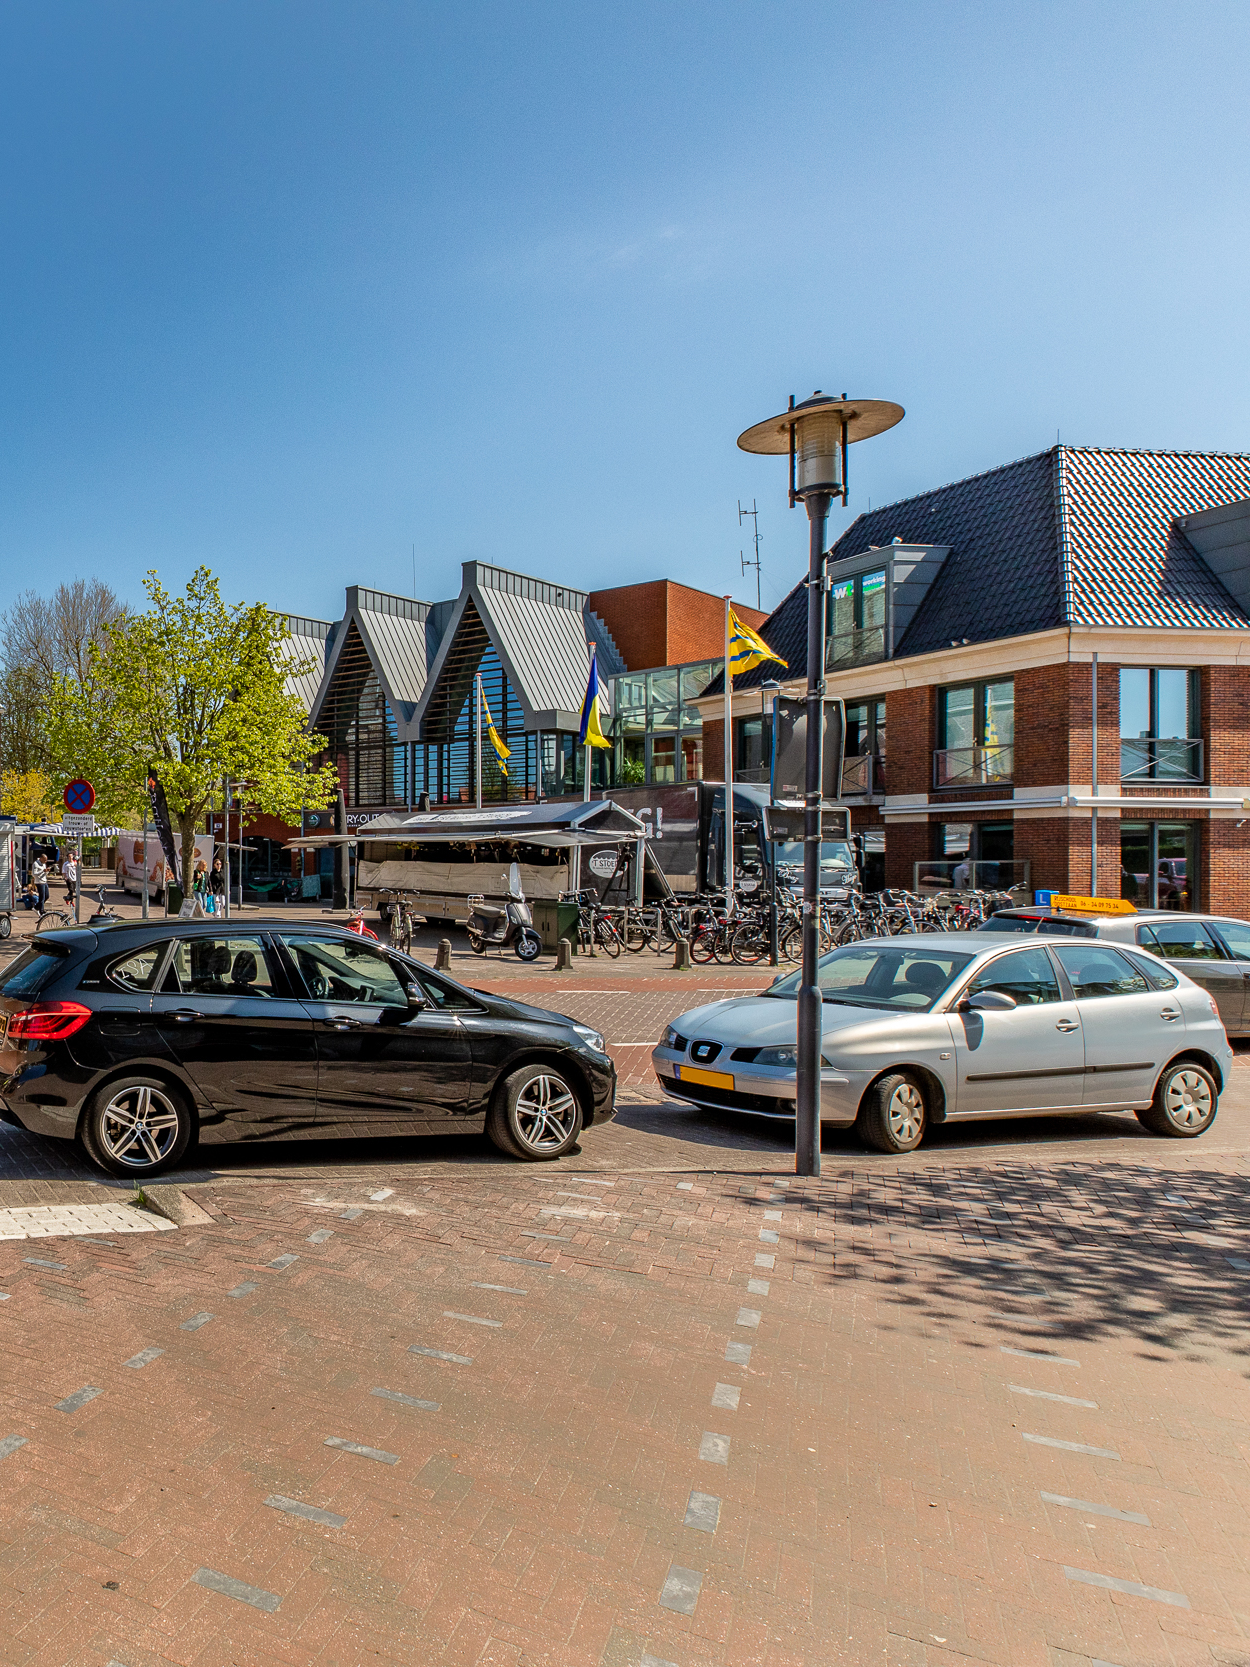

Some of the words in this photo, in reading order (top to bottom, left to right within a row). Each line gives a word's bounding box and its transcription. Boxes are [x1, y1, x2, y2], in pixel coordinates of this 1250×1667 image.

[345, 813, 380, 824] RY-OUT
[1039, 893, 1047, 904] L
[117, 957, 153, 980] ISA
